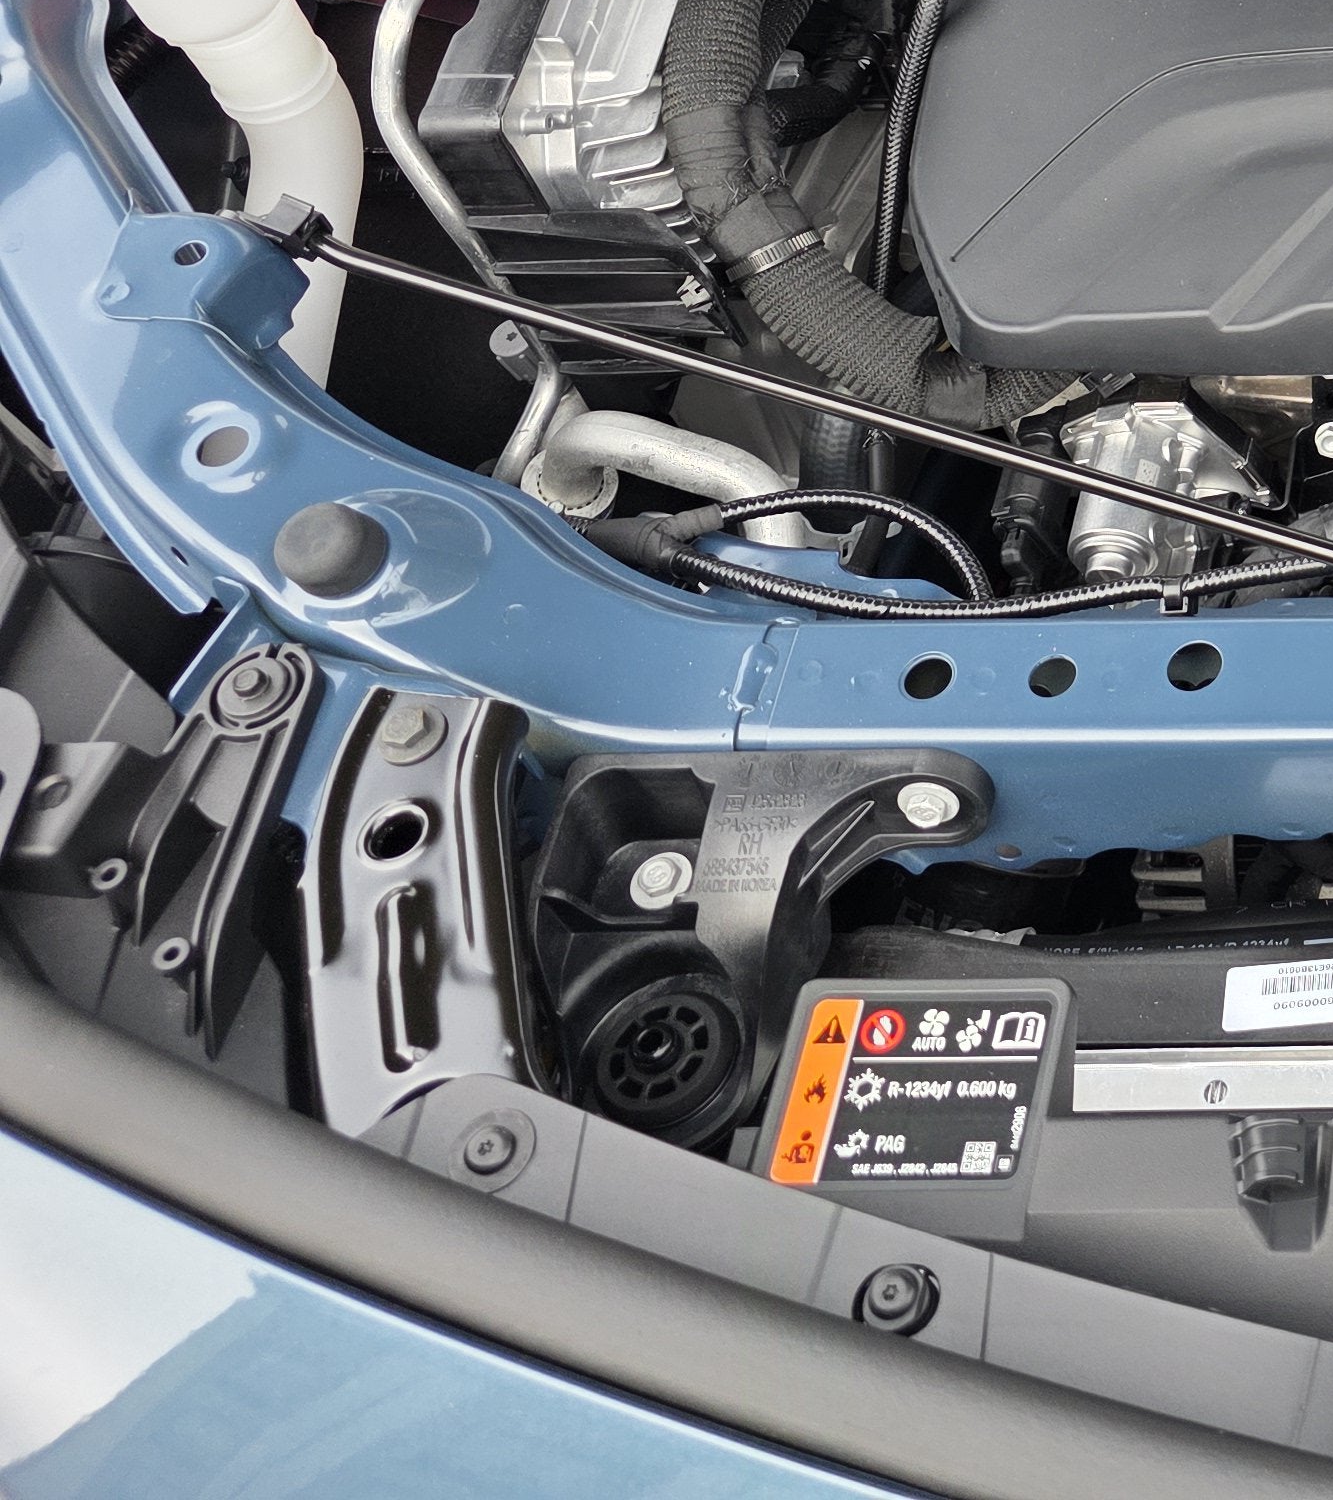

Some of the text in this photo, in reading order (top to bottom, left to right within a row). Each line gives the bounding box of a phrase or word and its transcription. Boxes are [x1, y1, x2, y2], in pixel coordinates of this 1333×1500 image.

[738, 833, 763, 855] RH
[695, 879, 726, 892] MADE
[729, 879, 739, 892] IN
[911, 1036, 947, 1052] AUTO
[887, 1080, 1017, 1102] R-1234yf 0.600 kg
[874, 1134, 906, 1154] PAG
[851, 1163, 870, 1175] SAE
